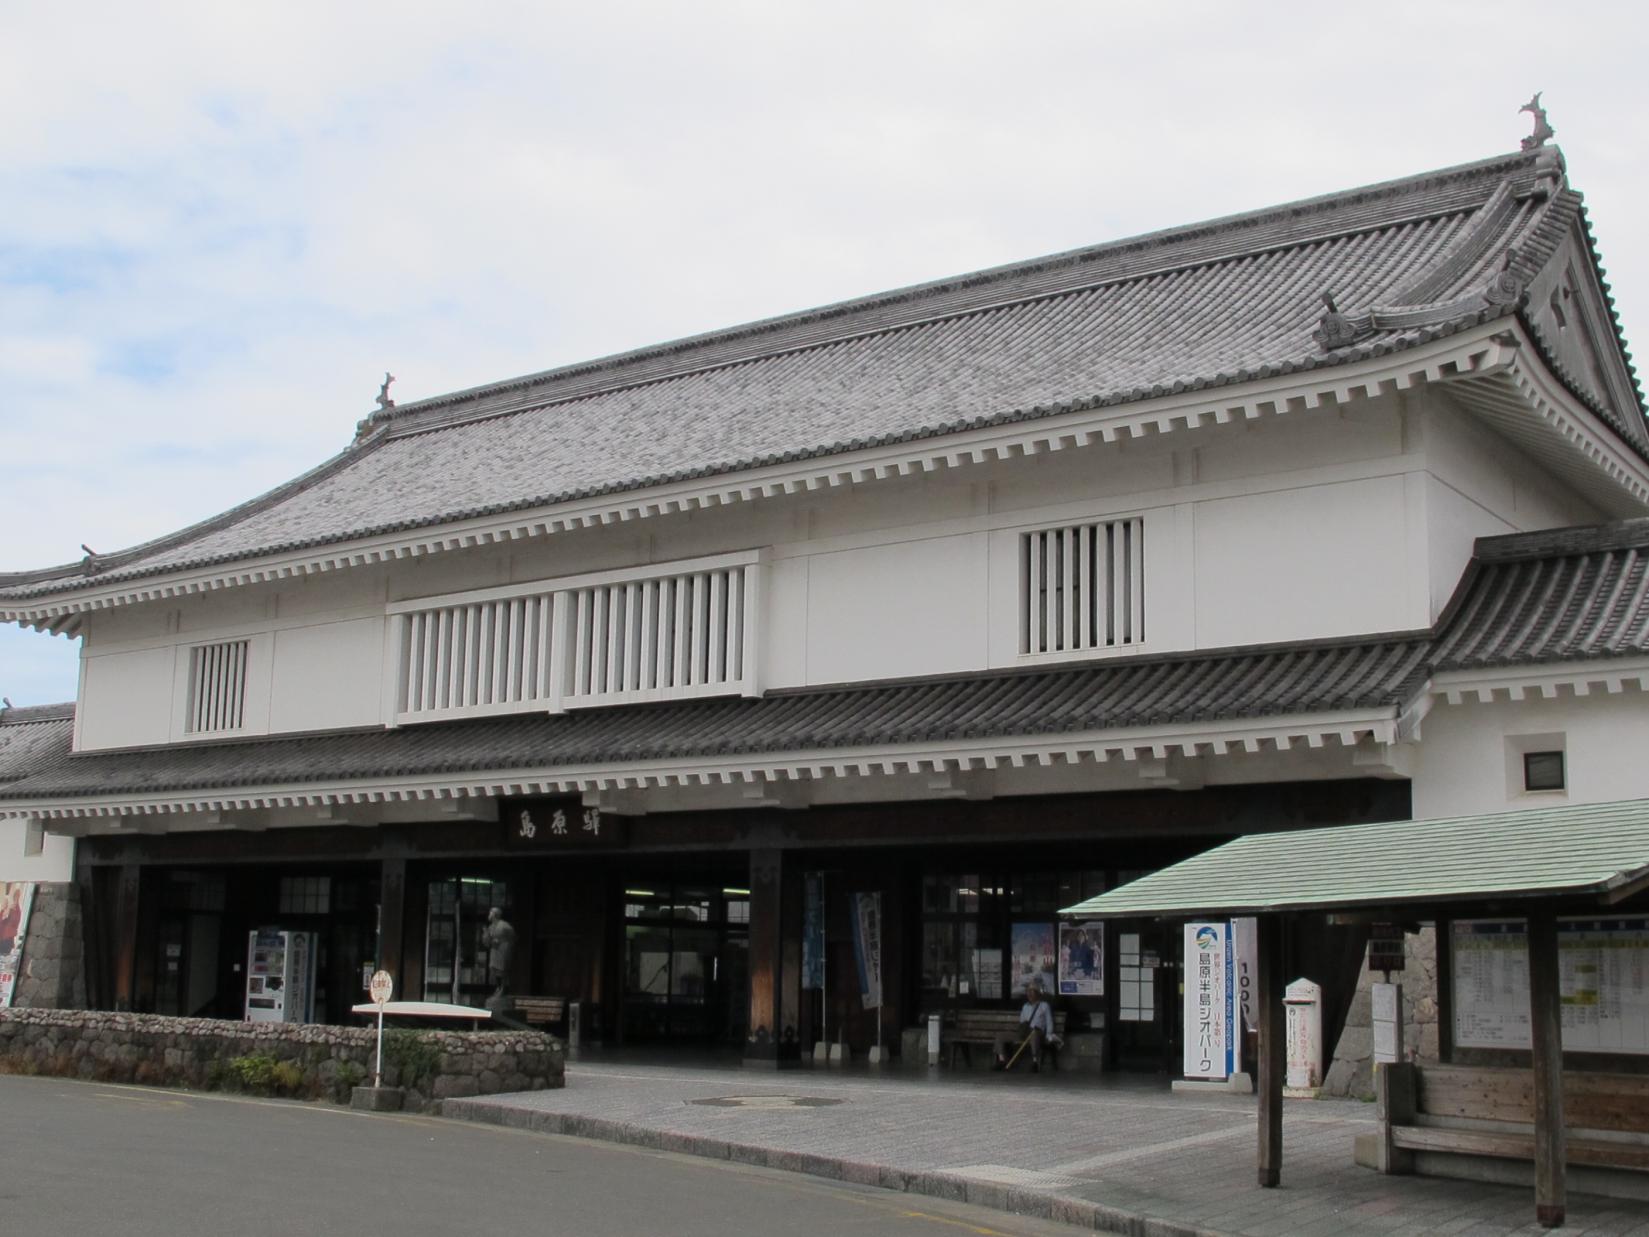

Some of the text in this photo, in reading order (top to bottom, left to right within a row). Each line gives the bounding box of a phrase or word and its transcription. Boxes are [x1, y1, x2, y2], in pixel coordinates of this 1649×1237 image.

[1199, 952, 1211, 1072] 島原半島ジオパーク
